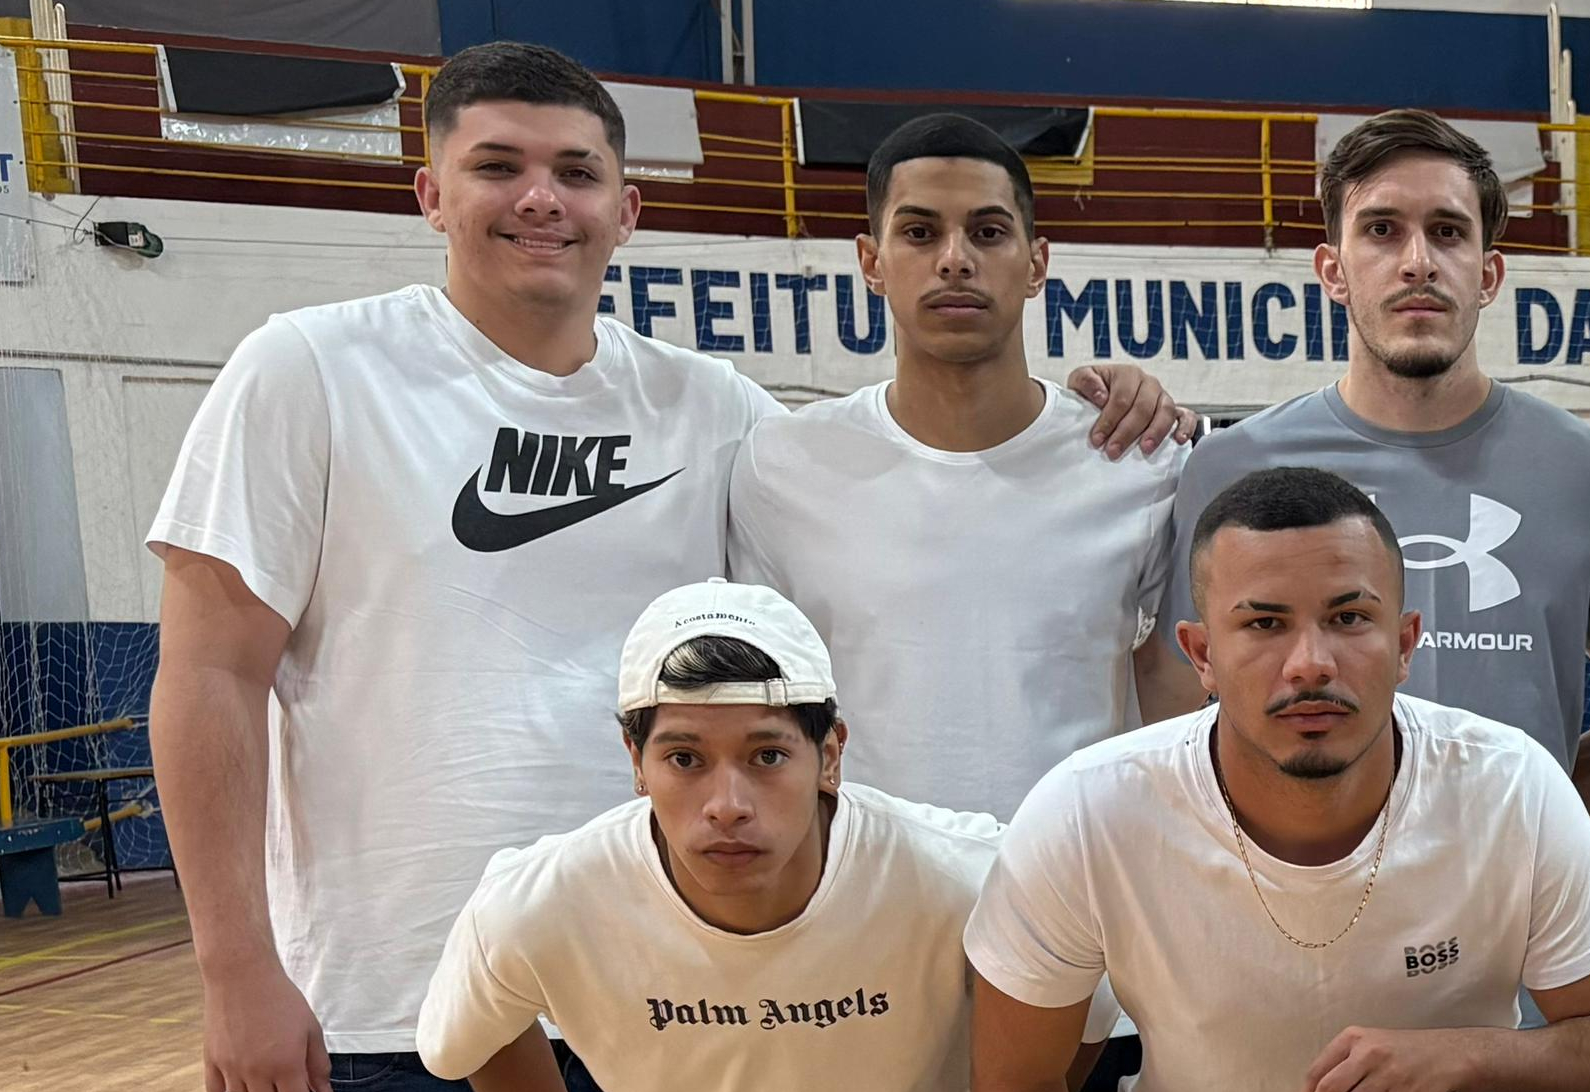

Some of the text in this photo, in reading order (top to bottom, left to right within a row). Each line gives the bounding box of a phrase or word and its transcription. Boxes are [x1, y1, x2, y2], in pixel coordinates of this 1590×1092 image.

[1045, 278, 1349, 361] MUNICI
[484, 427, 632, 496] NIKE
[1417, 631, 1533, 652] ARMOUR
[1405, 943, 1460, 970] BOSS
[646, 987, 890, 1031] Palm Angels
